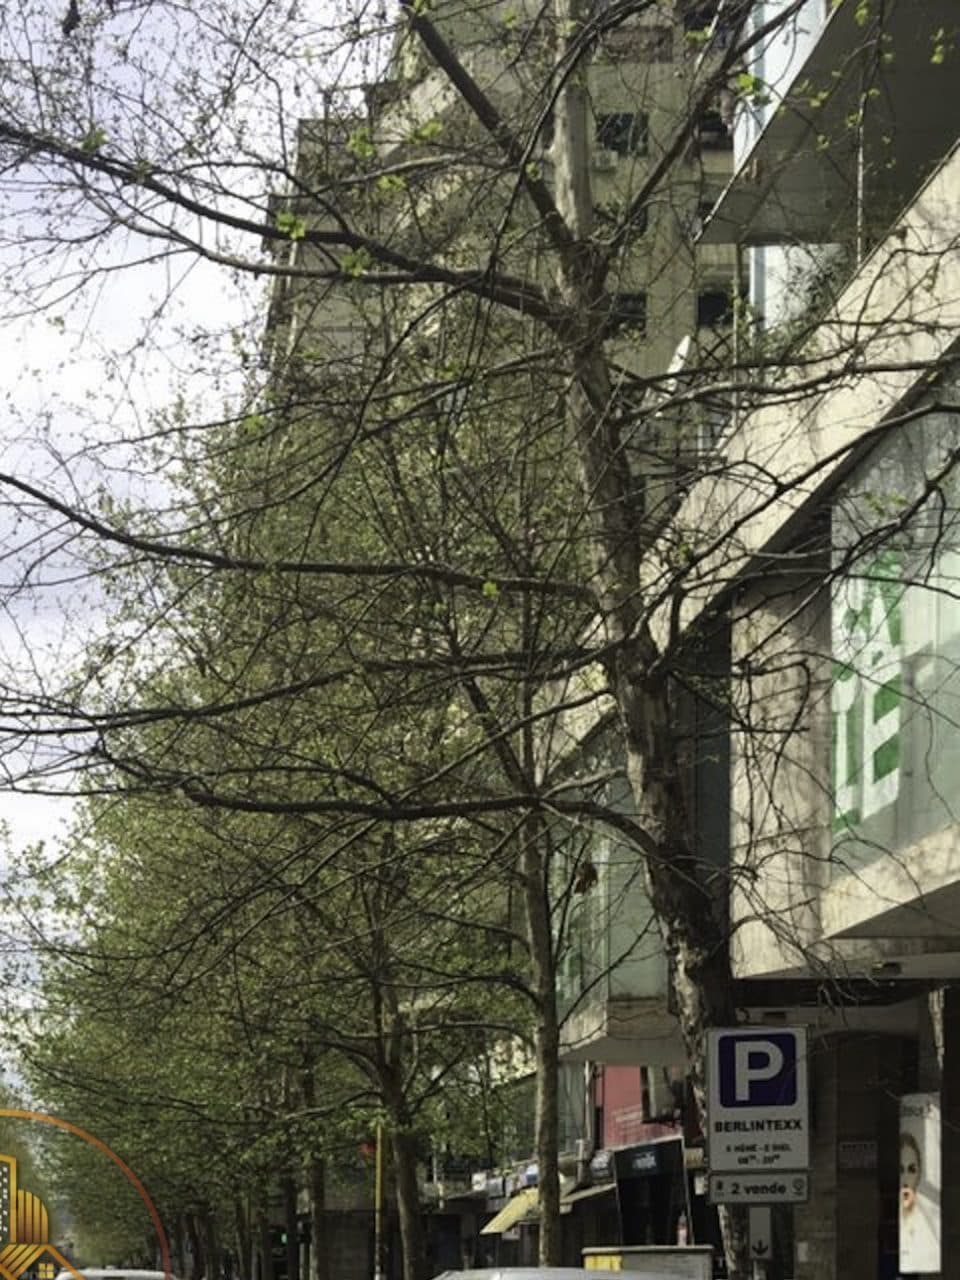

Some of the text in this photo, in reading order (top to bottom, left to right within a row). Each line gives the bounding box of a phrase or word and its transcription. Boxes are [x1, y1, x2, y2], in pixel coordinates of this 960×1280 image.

[735, 1040, 784, 1101] P
[714, 1119, 803, 1133] BERLINTEXX
[731, 1182, 787, 1195] 2 vende
